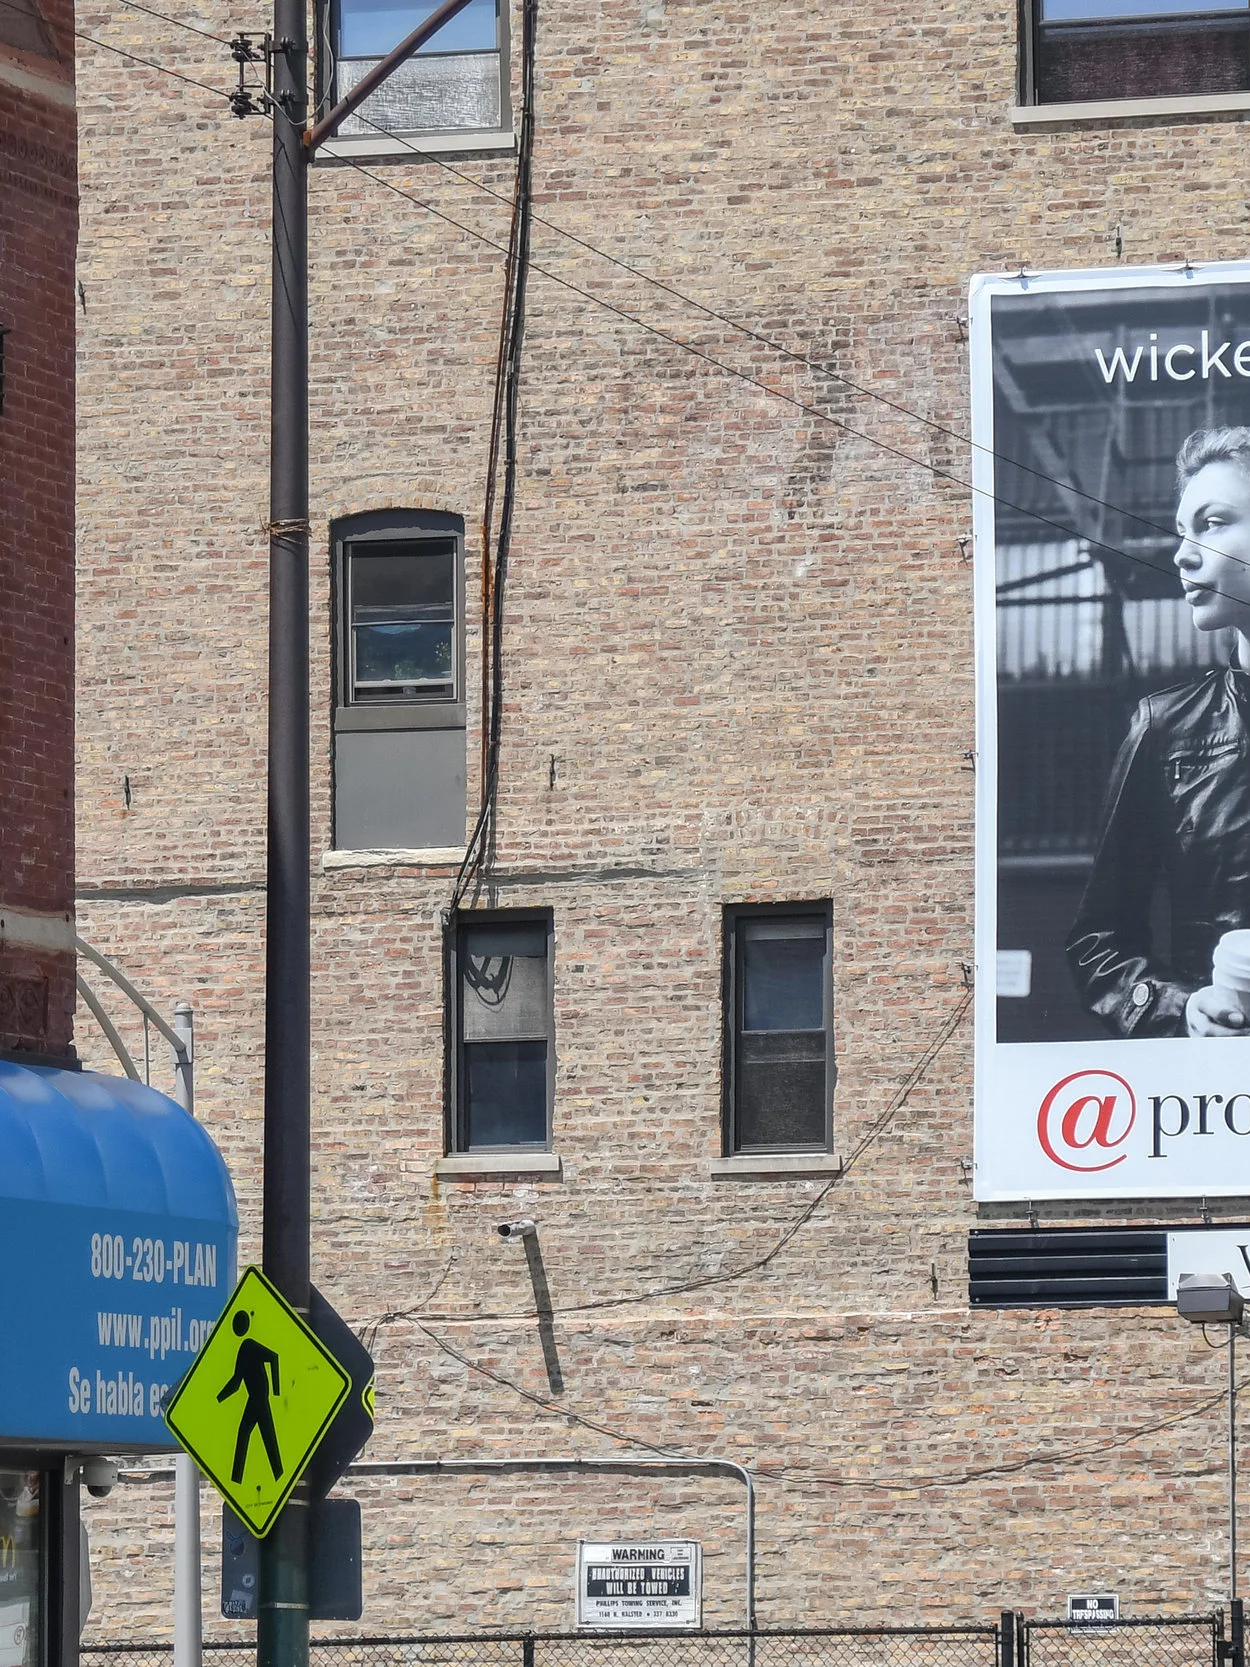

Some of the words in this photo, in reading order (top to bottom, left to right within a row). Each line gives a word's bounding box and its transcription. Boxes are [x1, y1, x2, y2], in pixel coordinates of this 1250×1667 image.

[91, 1233, 216, 1287] 800-230-PLAN
[98, 1307, 215, 1360] www.ppil.or
[69, 1367, 90, 1414] Se
[96, 1370, 144, 1416] habla
[612, 1549, 665, 1560] WARNING
[651, 1567, 685, 1580] VEHICLES
[606, 1582, 625, 1594] WILL
[627, 1582, 637, 1594] BE
[641, 1581, 668, 1594] TOWED
[1086, 1600, 1099, 1609] NO
